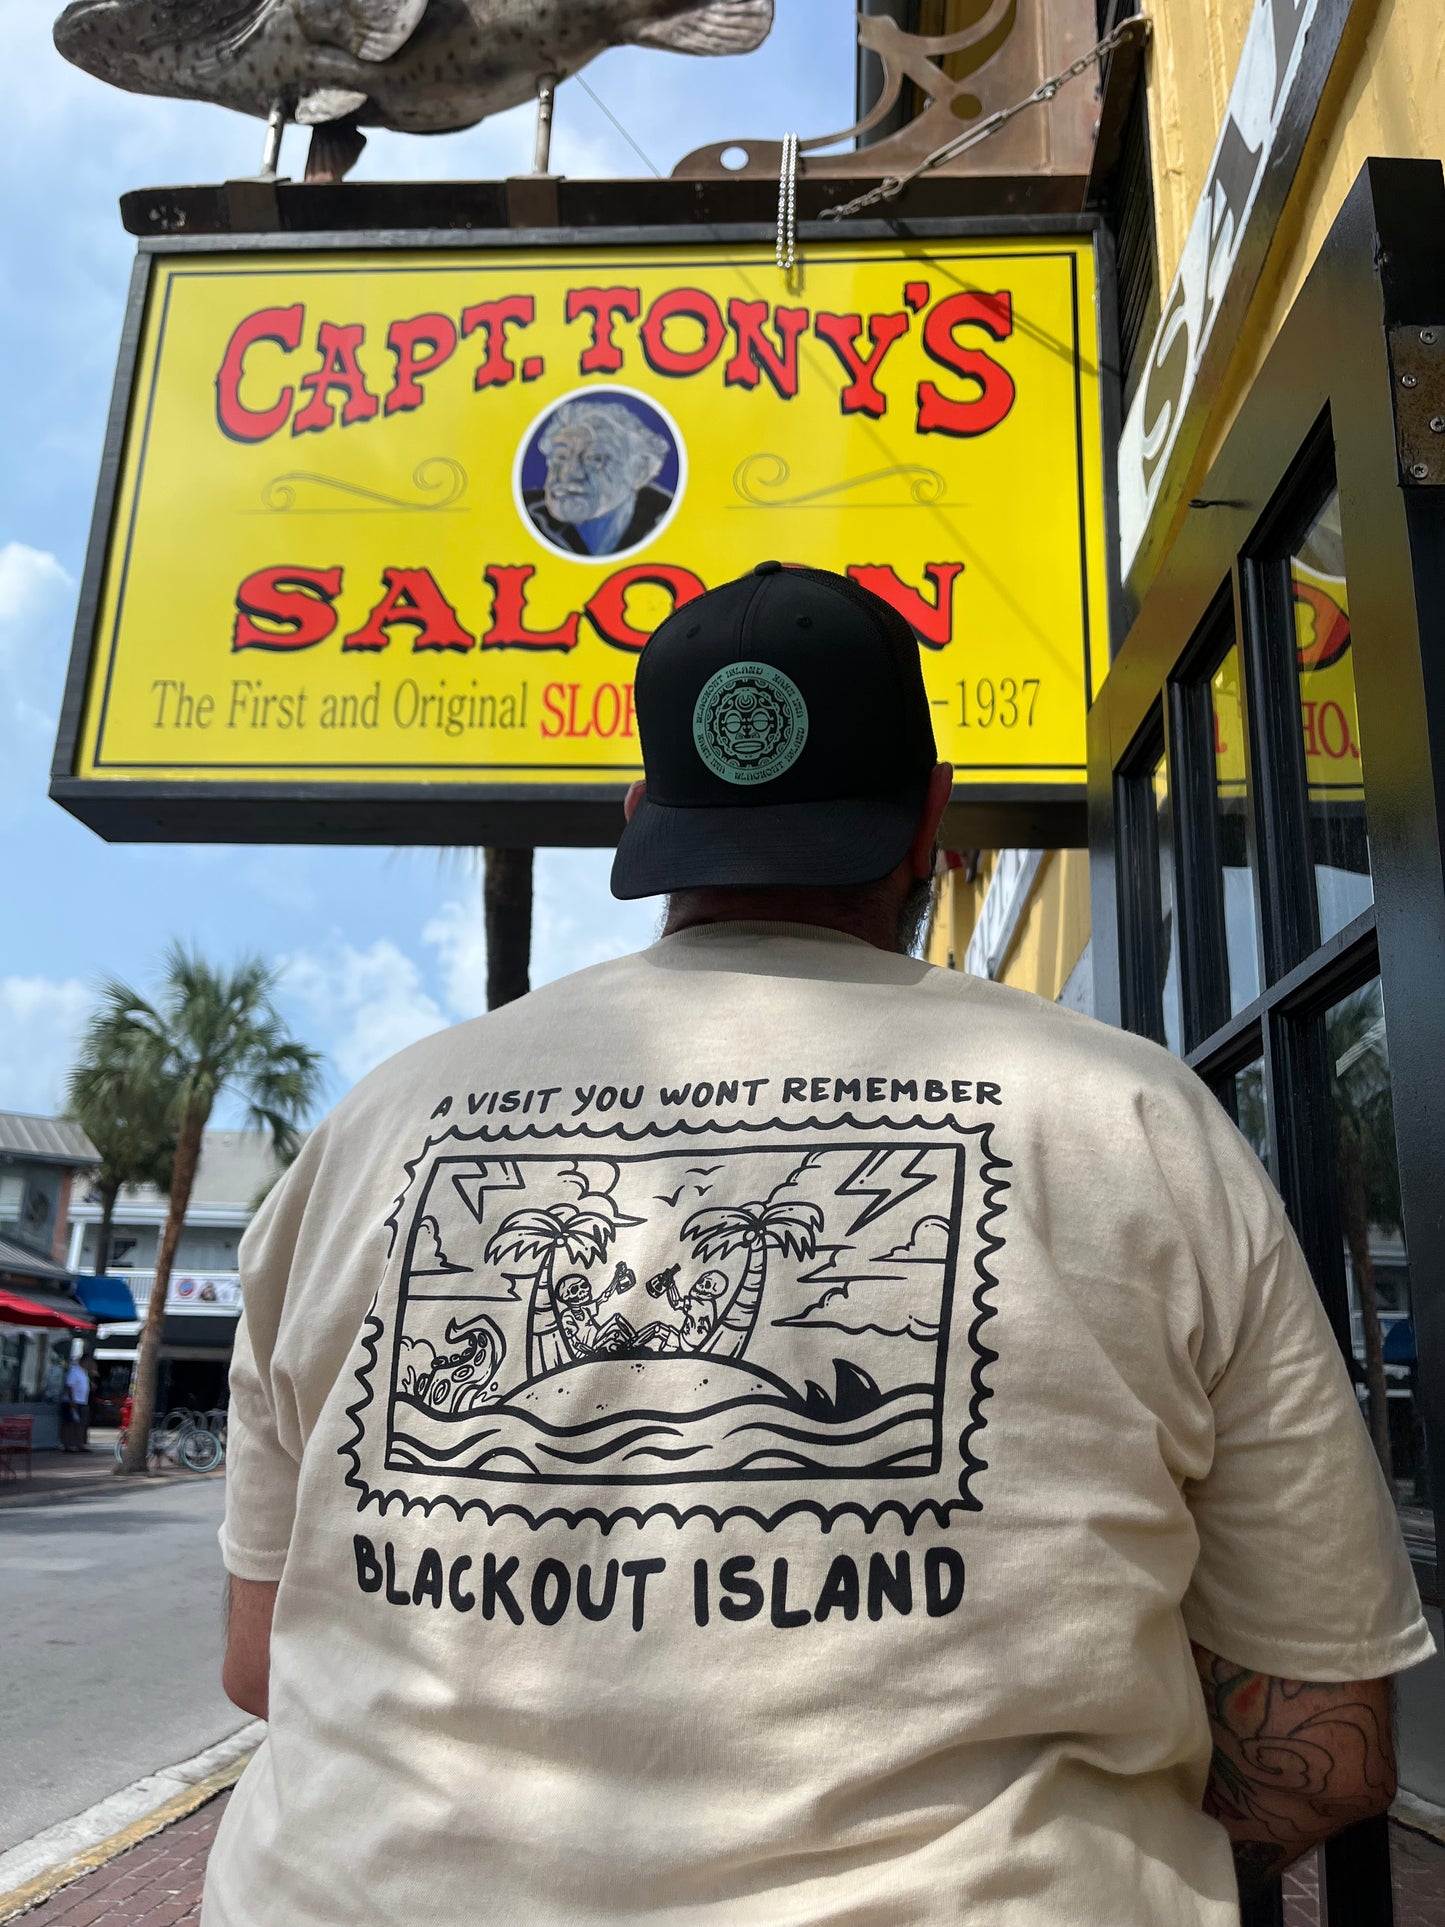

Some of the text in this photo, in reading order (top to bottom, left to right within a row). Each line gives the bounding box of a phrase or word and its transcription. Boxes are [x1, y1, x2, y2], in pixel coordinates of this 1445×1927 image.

[215, 281, 1016, 444] CAPT. TONY'S
[231, 563, 965, 653] SALON
[151, 679, 215, 729] The
[226, 679, 307, 729] First
[319, 680, 380, 728] and
[393, 679, 528, 737] Original
[430, 1077, 1003, 1120] A VISIT YOU WONT REMEMBER
[353, 1533, 966, 1633] BLACKOUT ISLAND
